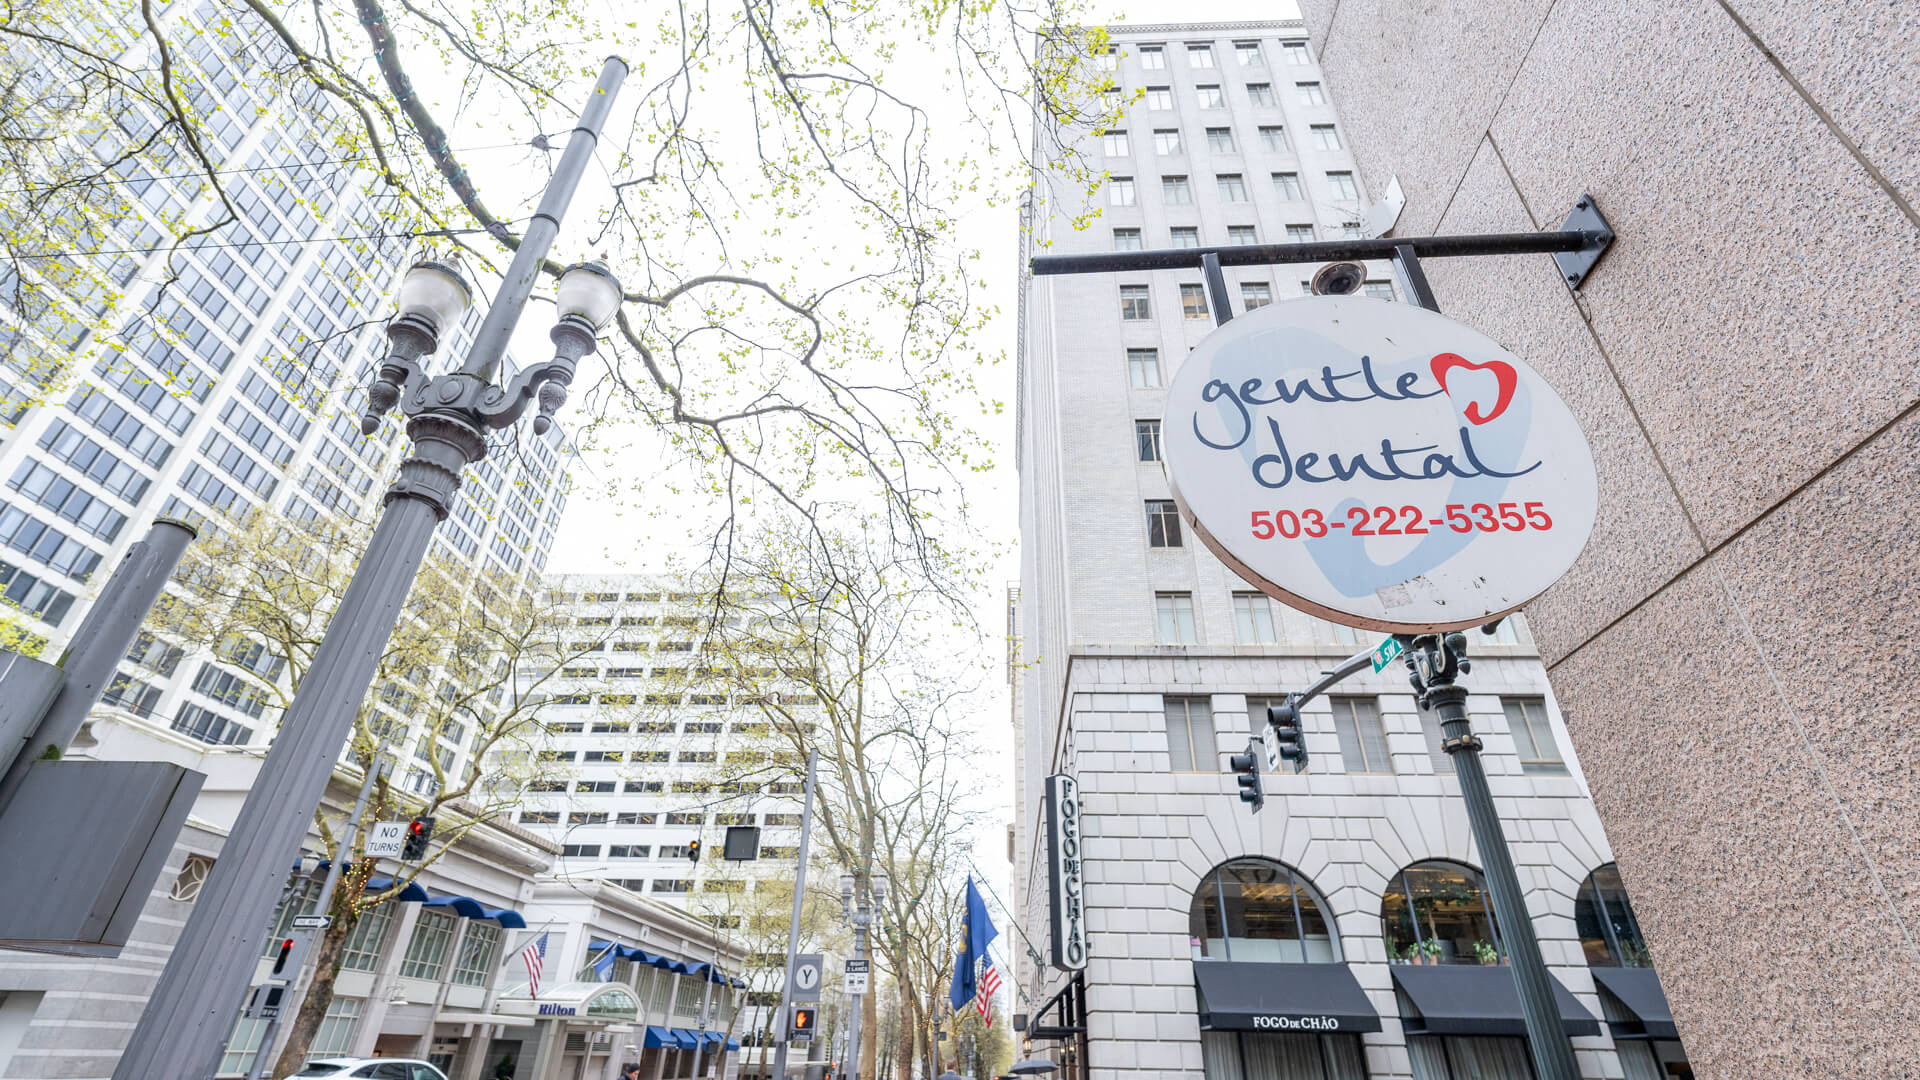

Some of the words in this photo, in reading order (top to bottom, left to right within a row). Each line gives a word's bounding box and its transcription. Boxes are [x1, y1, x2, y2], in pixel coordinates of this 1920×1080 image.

[1193, 356, 1446, 450] gentle
[1252, 416, 1543, 489] dental
[1251, 502, 1553, 539] 503-222-5355
[1383, 640, 1396, 661] SW
[1062, 780, 1079, 857] FOGO
[381, 827, 398, 838] NO
[369, 842, 400, 852] TURNS
[803, 969, 813, 985] Y
[538, 1003, 577, 1016] Hilton
[1253, 1016, 1289, 1028] FOGO
[1290, 1020, 1301, 1029] DE
